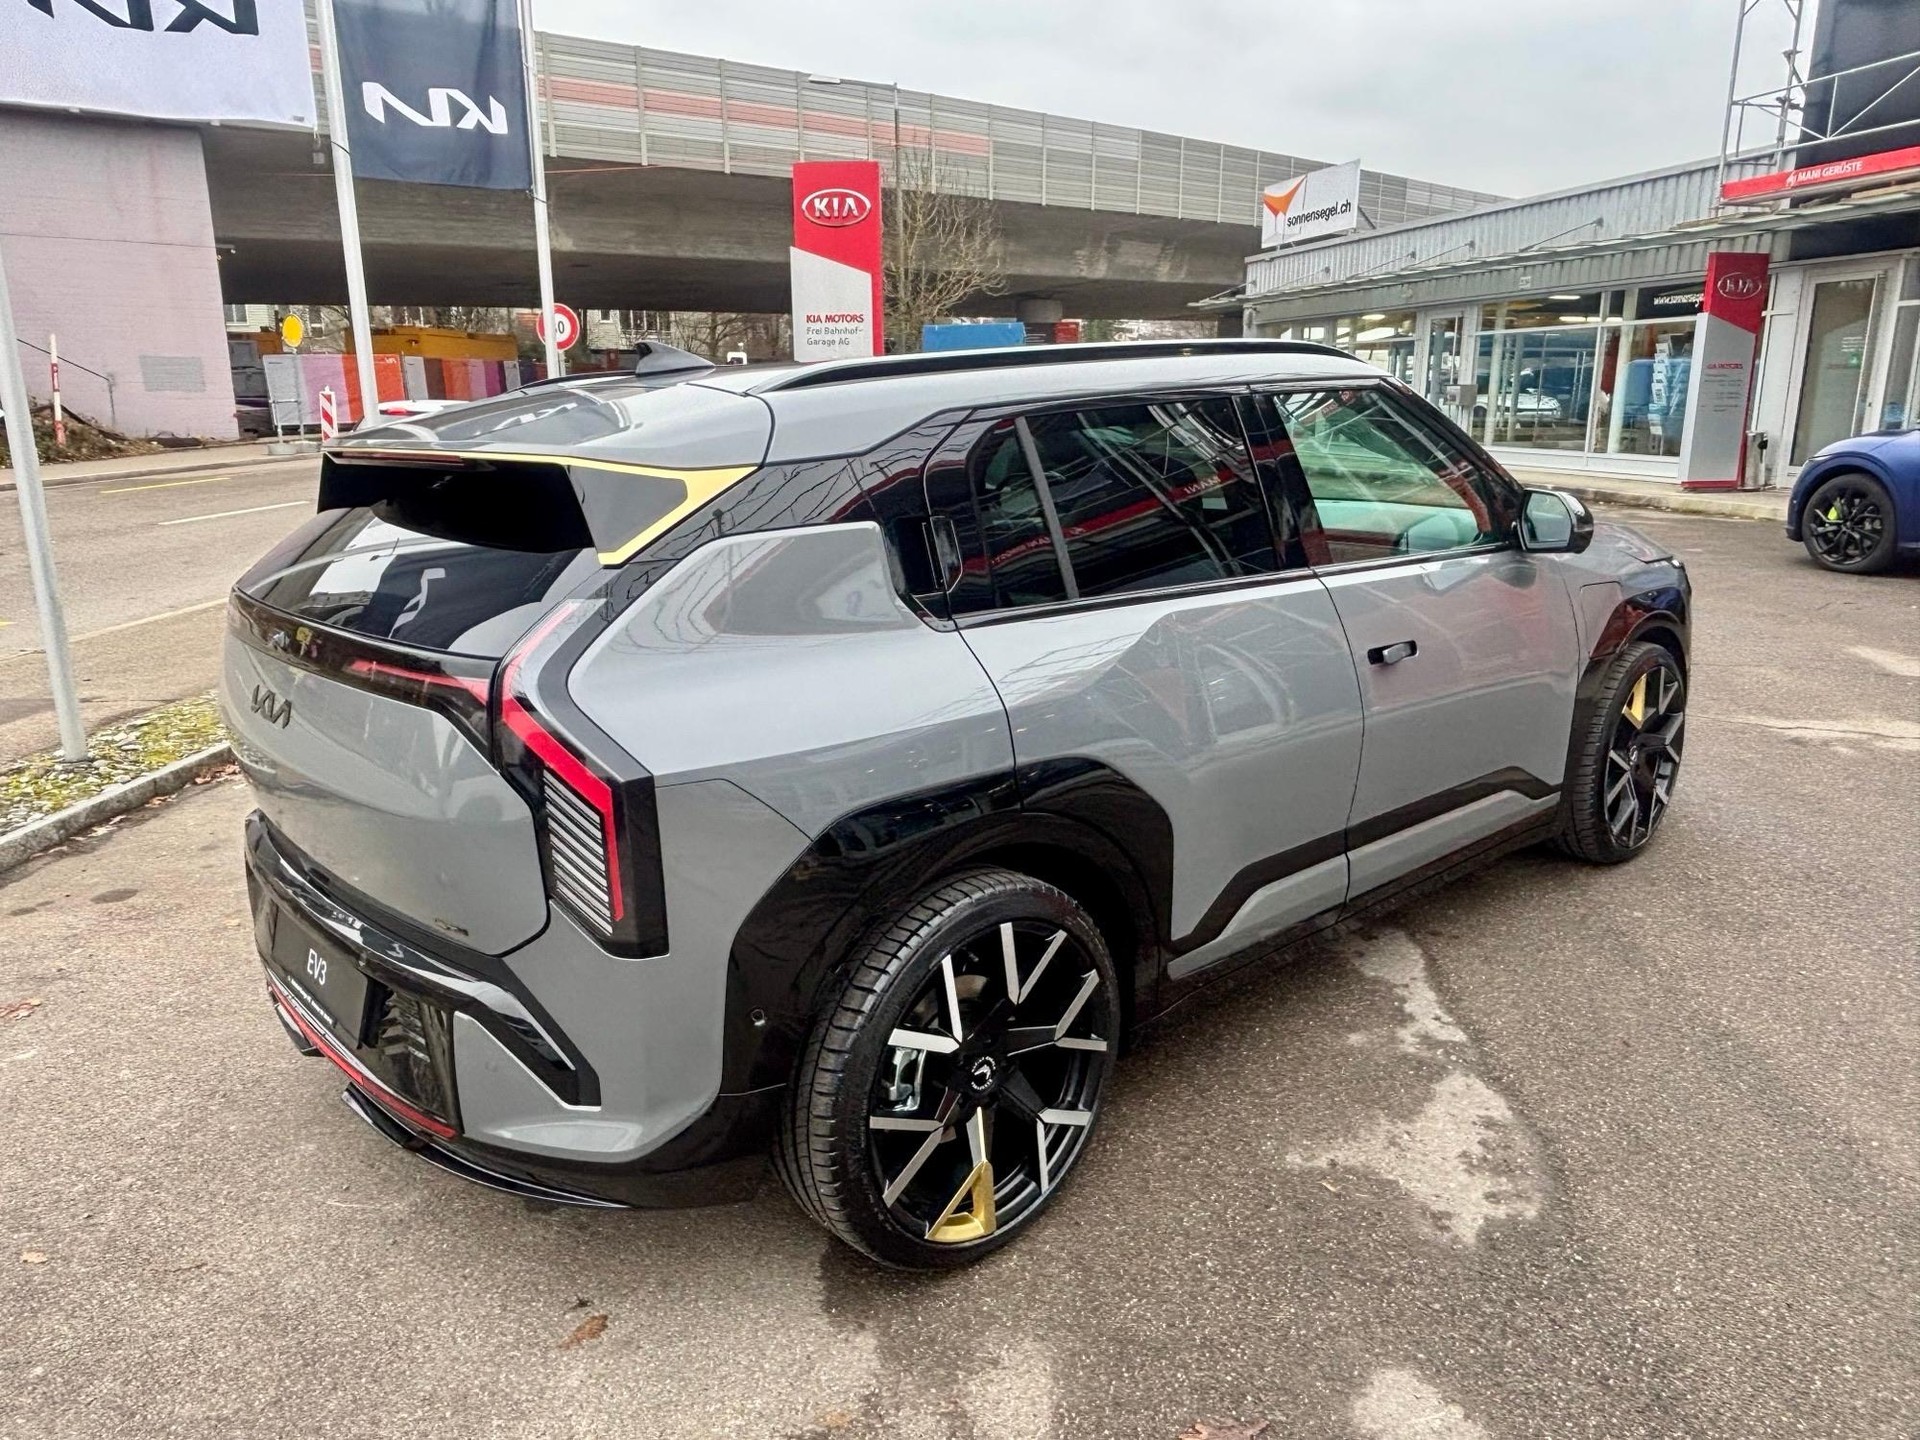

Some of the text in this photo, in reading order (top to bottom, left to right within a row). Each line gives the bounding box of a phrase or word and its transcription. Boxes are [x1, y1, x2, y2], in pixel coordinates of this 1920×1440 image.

[1797, 160, 1863, 182] MANI GERÜSTE
[813, 197, 860, 218] KIA
[1287, 198, 1352, 227] sonnensegel.ch
[806, 313, 864, 324] KIA MOTORS
[806, 326, 864, 335] Frei Bahnhof-
[806, 337, 850, 347] Garage AG
[307, 948, 327, 986] EV3
